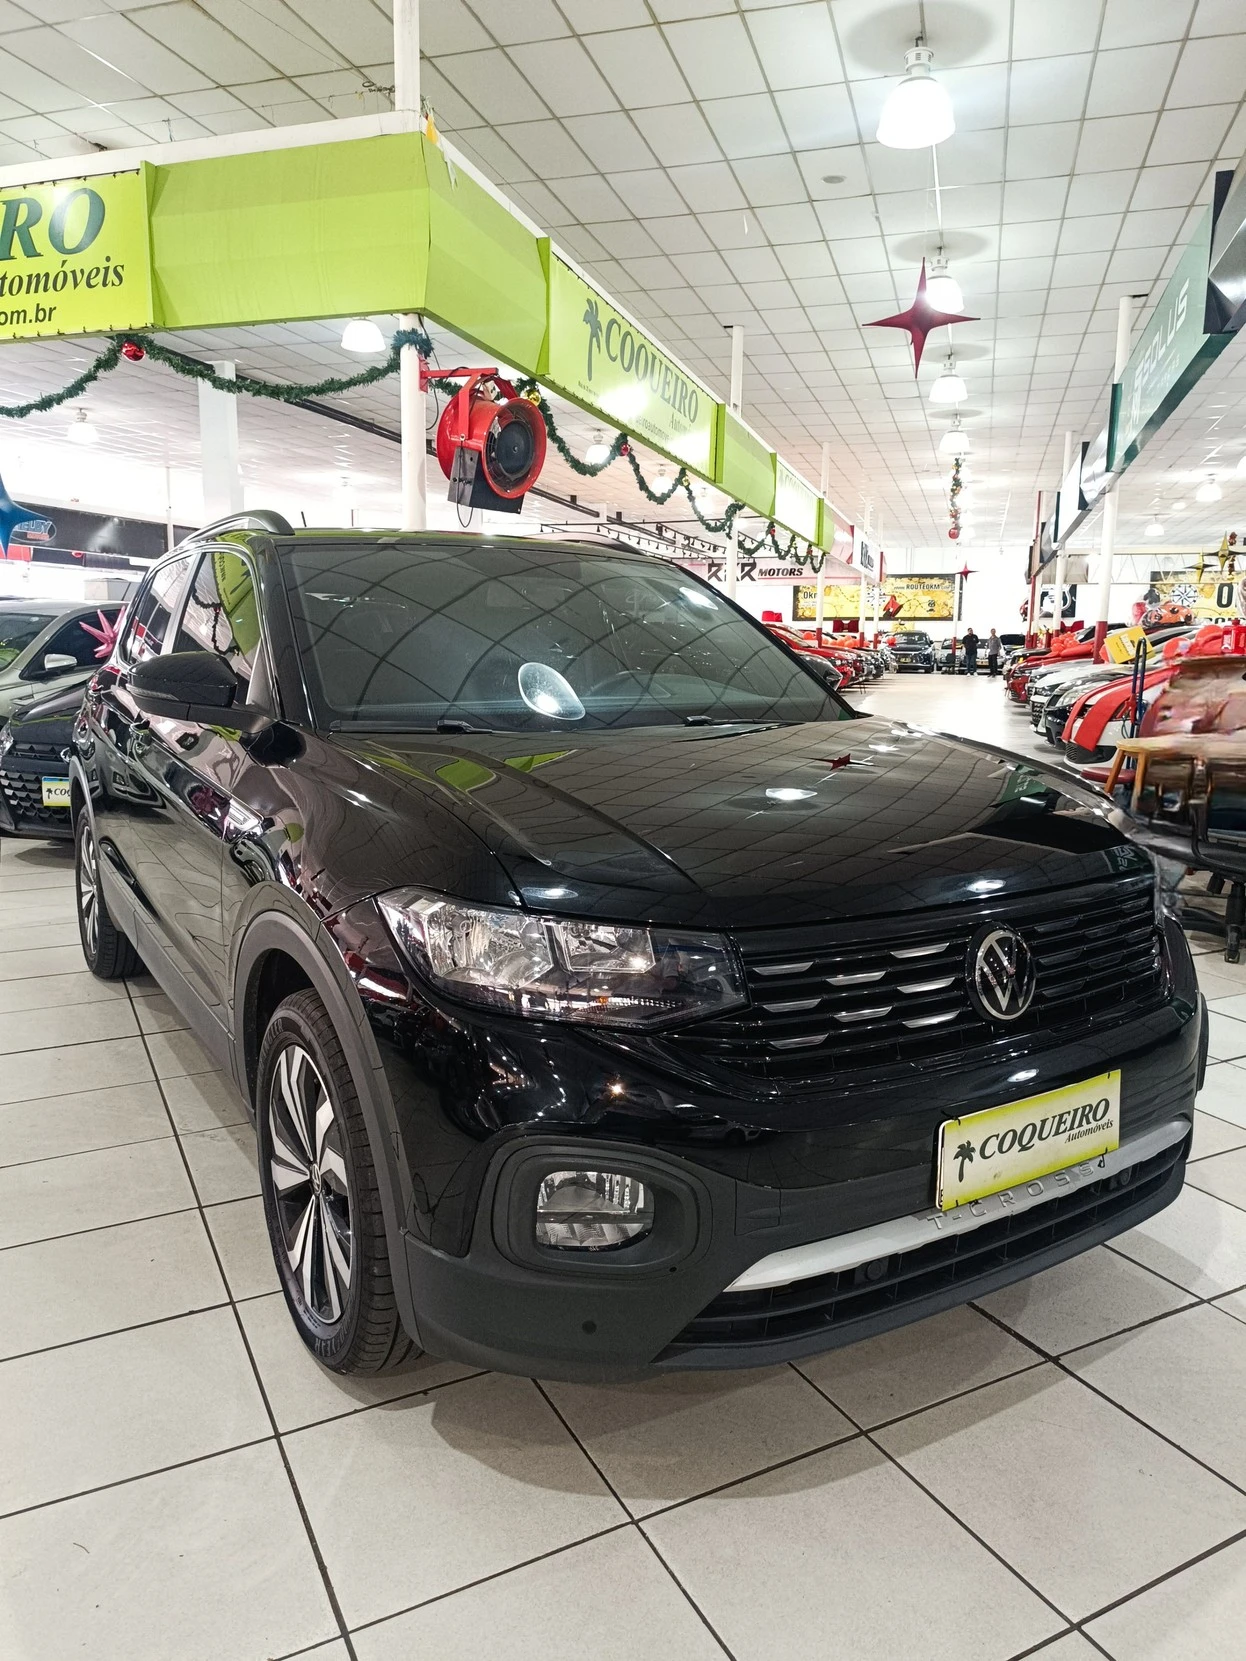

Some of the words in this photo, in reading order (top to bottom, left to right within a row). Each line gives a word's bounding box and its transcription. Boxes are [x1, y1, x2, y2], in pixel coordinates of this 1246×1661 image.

[605, 317, 698, 424] COQUEIRO
[758, 567, 804, 577] MOTORS
[979, 1098, 1110, 1160] COQUEIRO
[1064, 1119, 1114, 1144] Automóveis
[926, 1161, 1094, 1230] T-CROSS
